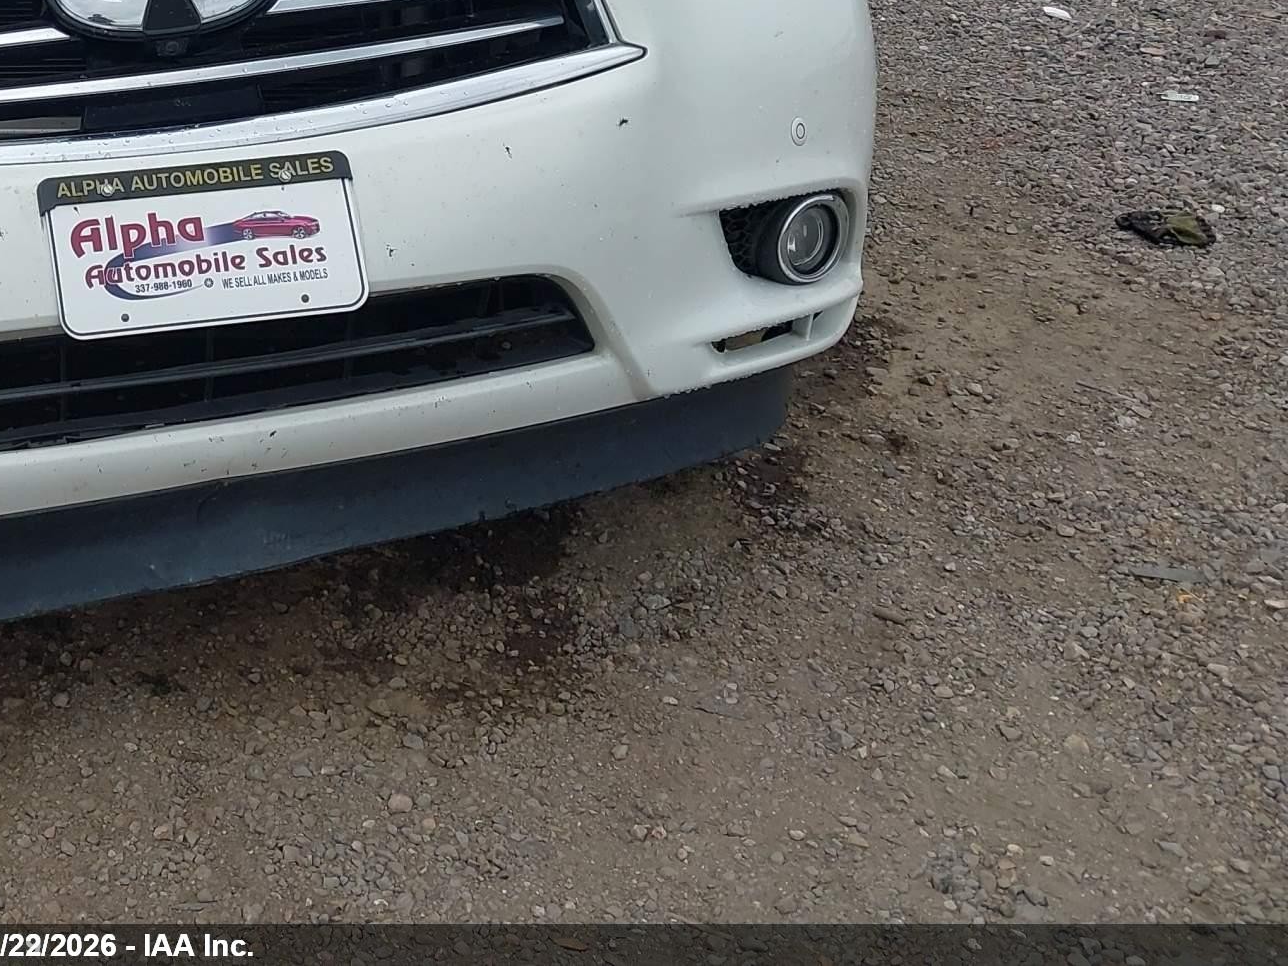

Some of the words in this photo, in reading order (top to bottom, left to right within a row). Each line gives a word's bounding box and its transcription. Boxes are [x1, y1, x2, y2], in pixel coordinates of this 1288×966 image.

[57, 177, 125, 198] ALPHA
[131, 164, 264, 192] AUTOMOBILE
[269, 156, 334, 178] SALES
[70, 212, 206, 258] Alpha
[85, 249, 246, 289] Automobile
[258, 244, 328, 269] Sales
[222, 277, 234, 289] WE
[234, 275, 253, 288] SELL
[253, 274, 267, 286] ALL
[267, 271, 292, 284] MAKES
[293, 271, 299, 282] &
[299, 267, 329, 281] MODELS
